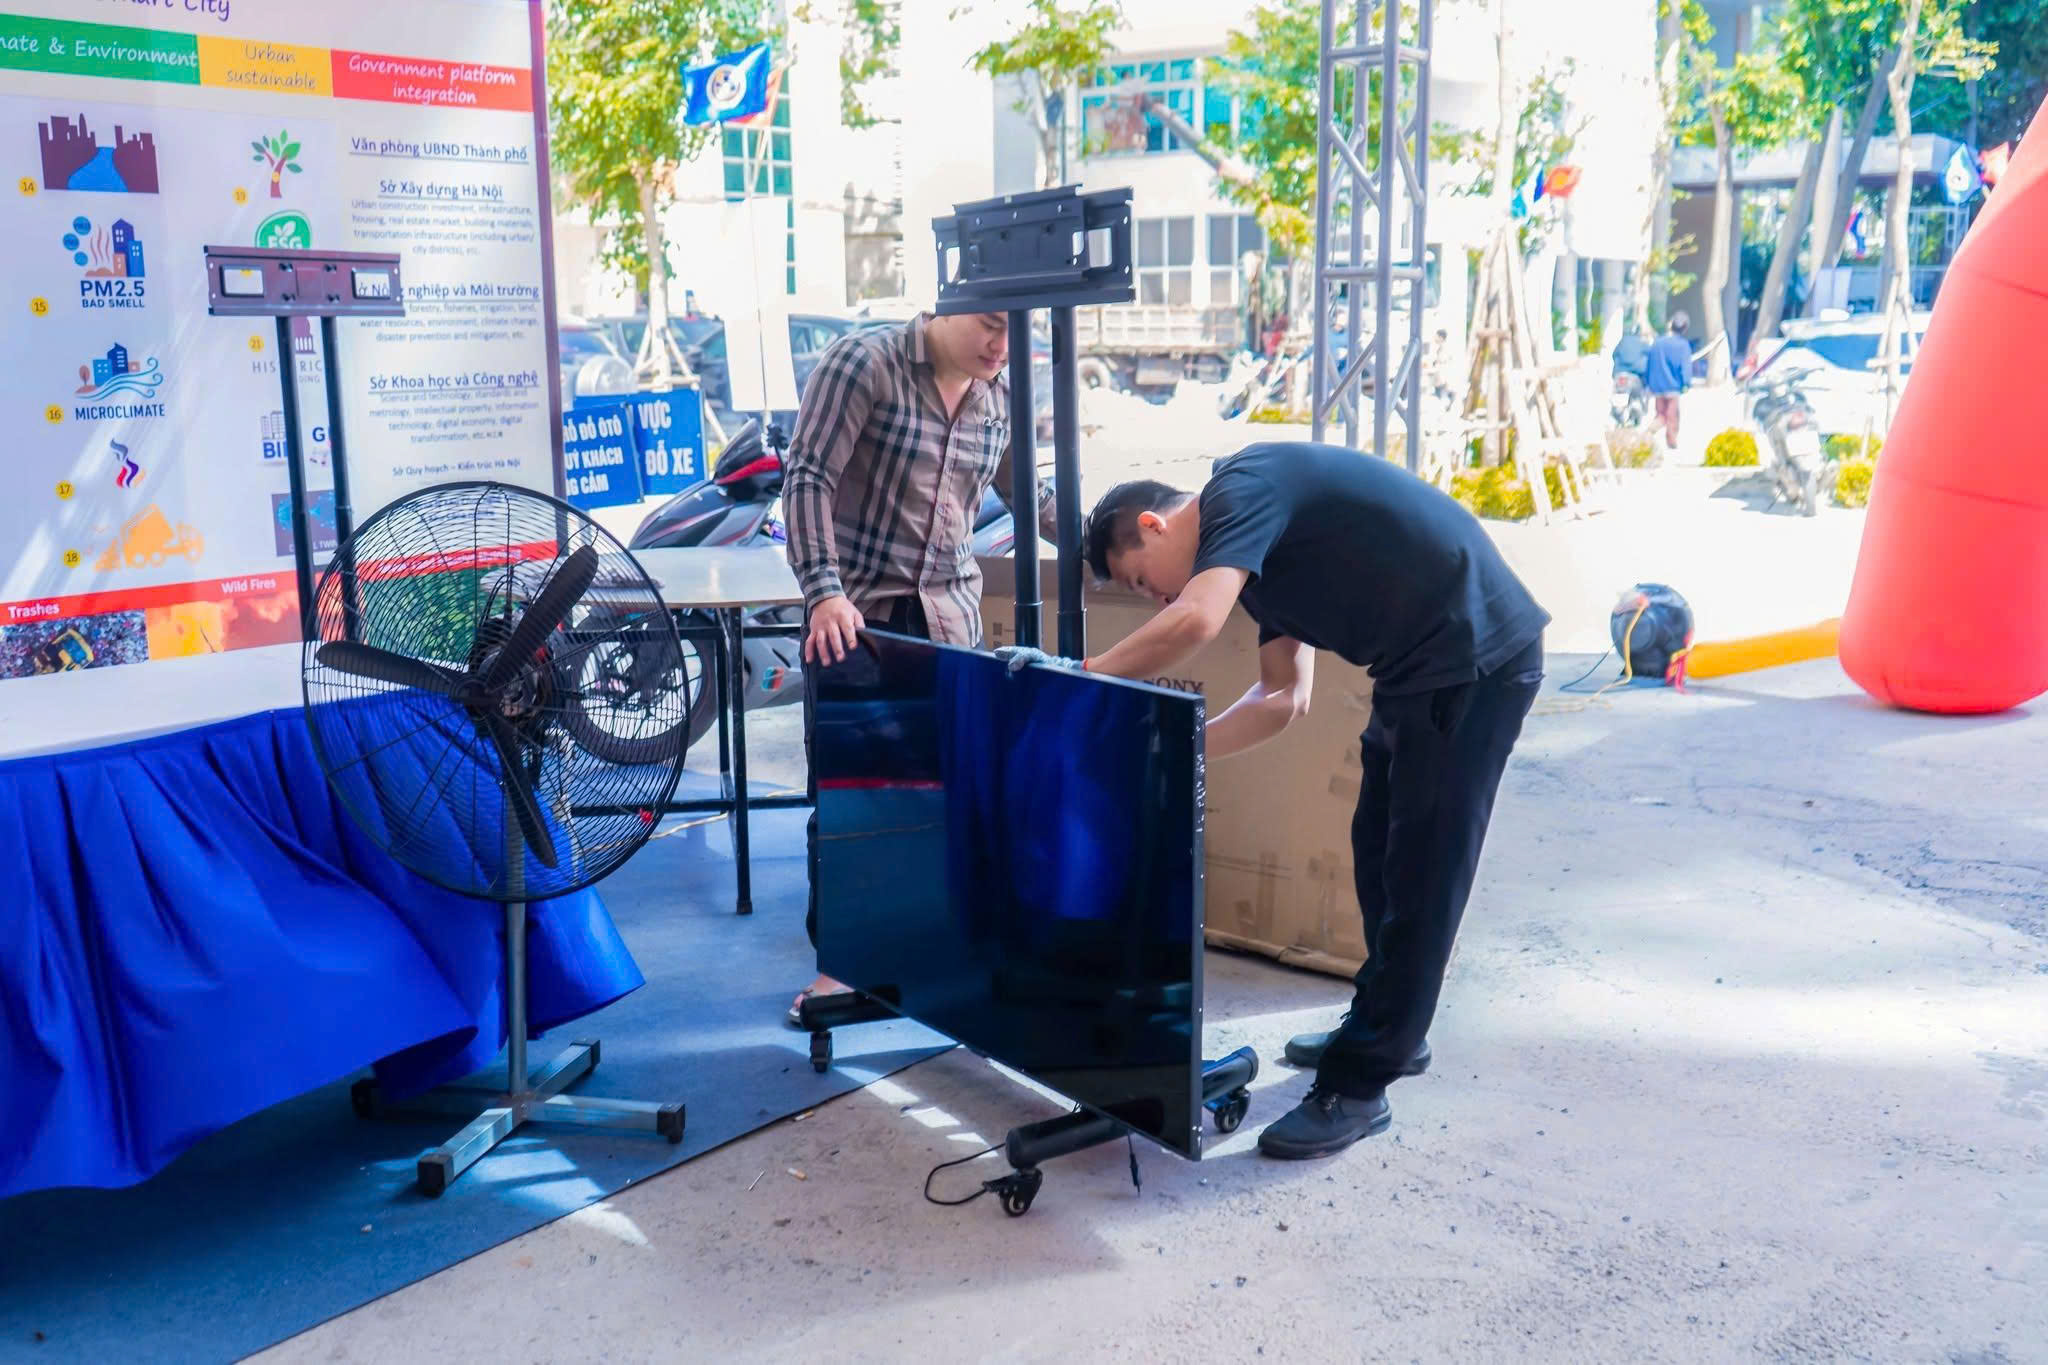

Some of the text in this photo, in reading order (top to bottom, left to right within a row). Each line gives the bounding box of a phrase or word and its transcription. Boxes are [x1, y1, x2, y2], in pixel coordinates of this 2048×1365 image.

[49, 37, 65, 55] &
[75, 40, 198, 67] Environment
[244, 44, 296, 63] Urban
[227, 68, 315, 89] sustainable
[349, 54, 516, 91] Government platform
[393, 82, 477, 105] integration
[352, 137, 528, 162] Văn phòng UBND Thành phố
[23, 182, 34, 192] 14
[380, 180, 503, 200] Sở Xây dựng Hà Nội
[80, 280, 145, 297] PM2.5
[408, 284, 449, 299] nghiệp
[453, 285, 466, 296] và
[470, 284, 493, 296] Môi
[497, 285, 539, 299] trường
[34, 302, 46, 312] 15
[82, 299, 145, 308] BAD SMELL
[252, 360, 322, 373] HISRIC
[370, 370, 538, 391] Sở Khoa học và Công nghệ
[50, 409, 61, 420] 16
[75, 404, 165, 420] MICROCLIMATE
[638, 399, 672, 436] VỰC
[598, 414, 623, 438] ÔTÔ
[581, 445, 624, 469] KHÁCH
[671, 447, 695, 475] XE
[59, 485, 70, 495] 17
[67, 553, 78, 563] 18
[221, 578, 277, 593] Wild Fires
[8, 602, 60, 619] Trashes
[1152, 676, 1204, 694] ONY
